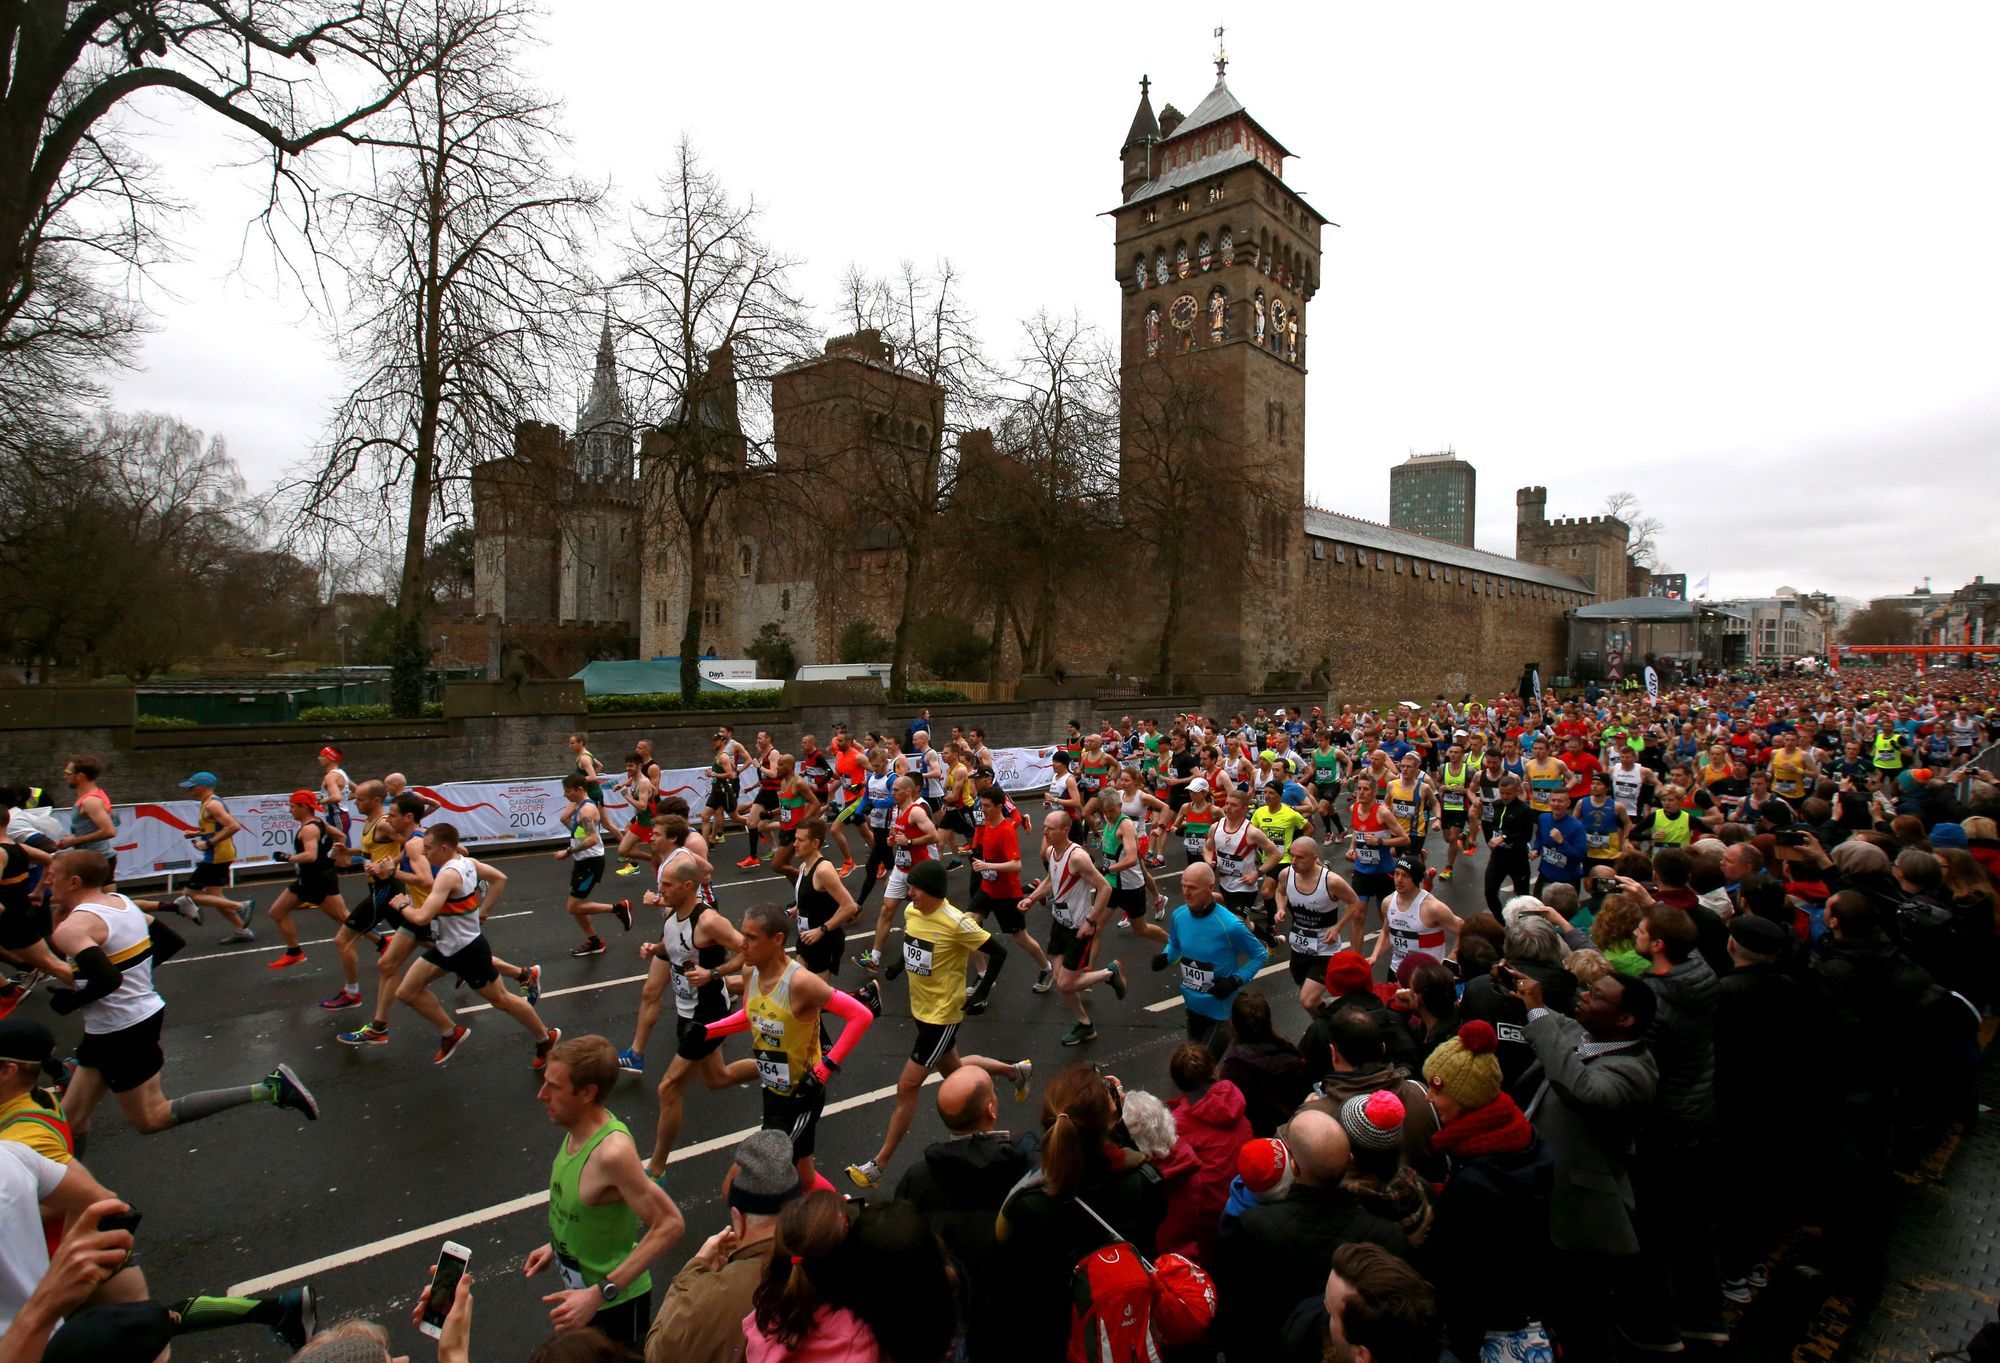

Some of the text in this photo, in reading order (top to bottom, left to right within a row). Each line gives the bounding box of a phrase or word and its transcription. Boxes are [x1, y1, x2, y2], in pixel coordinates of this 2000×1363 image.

[709, 671, 724, 679] Days
[998, 771, 1020, 781] 2016
[510, 804, 545, 814] CARDIFF
[1396, 804, 1409, 813] 508
[510, 811, 546, 828] 2016
[1359, 849, 1373, 858] 982
[1220, 858, 1235, 869] 786
[1294, 934, 1309, 947] 736
[1393, 937, 1408, 948] 614
[907, 946, 922, 962] 198
[1184, 966, 1205, 982] 1401
[756, 1060, 779, 1077] 964
